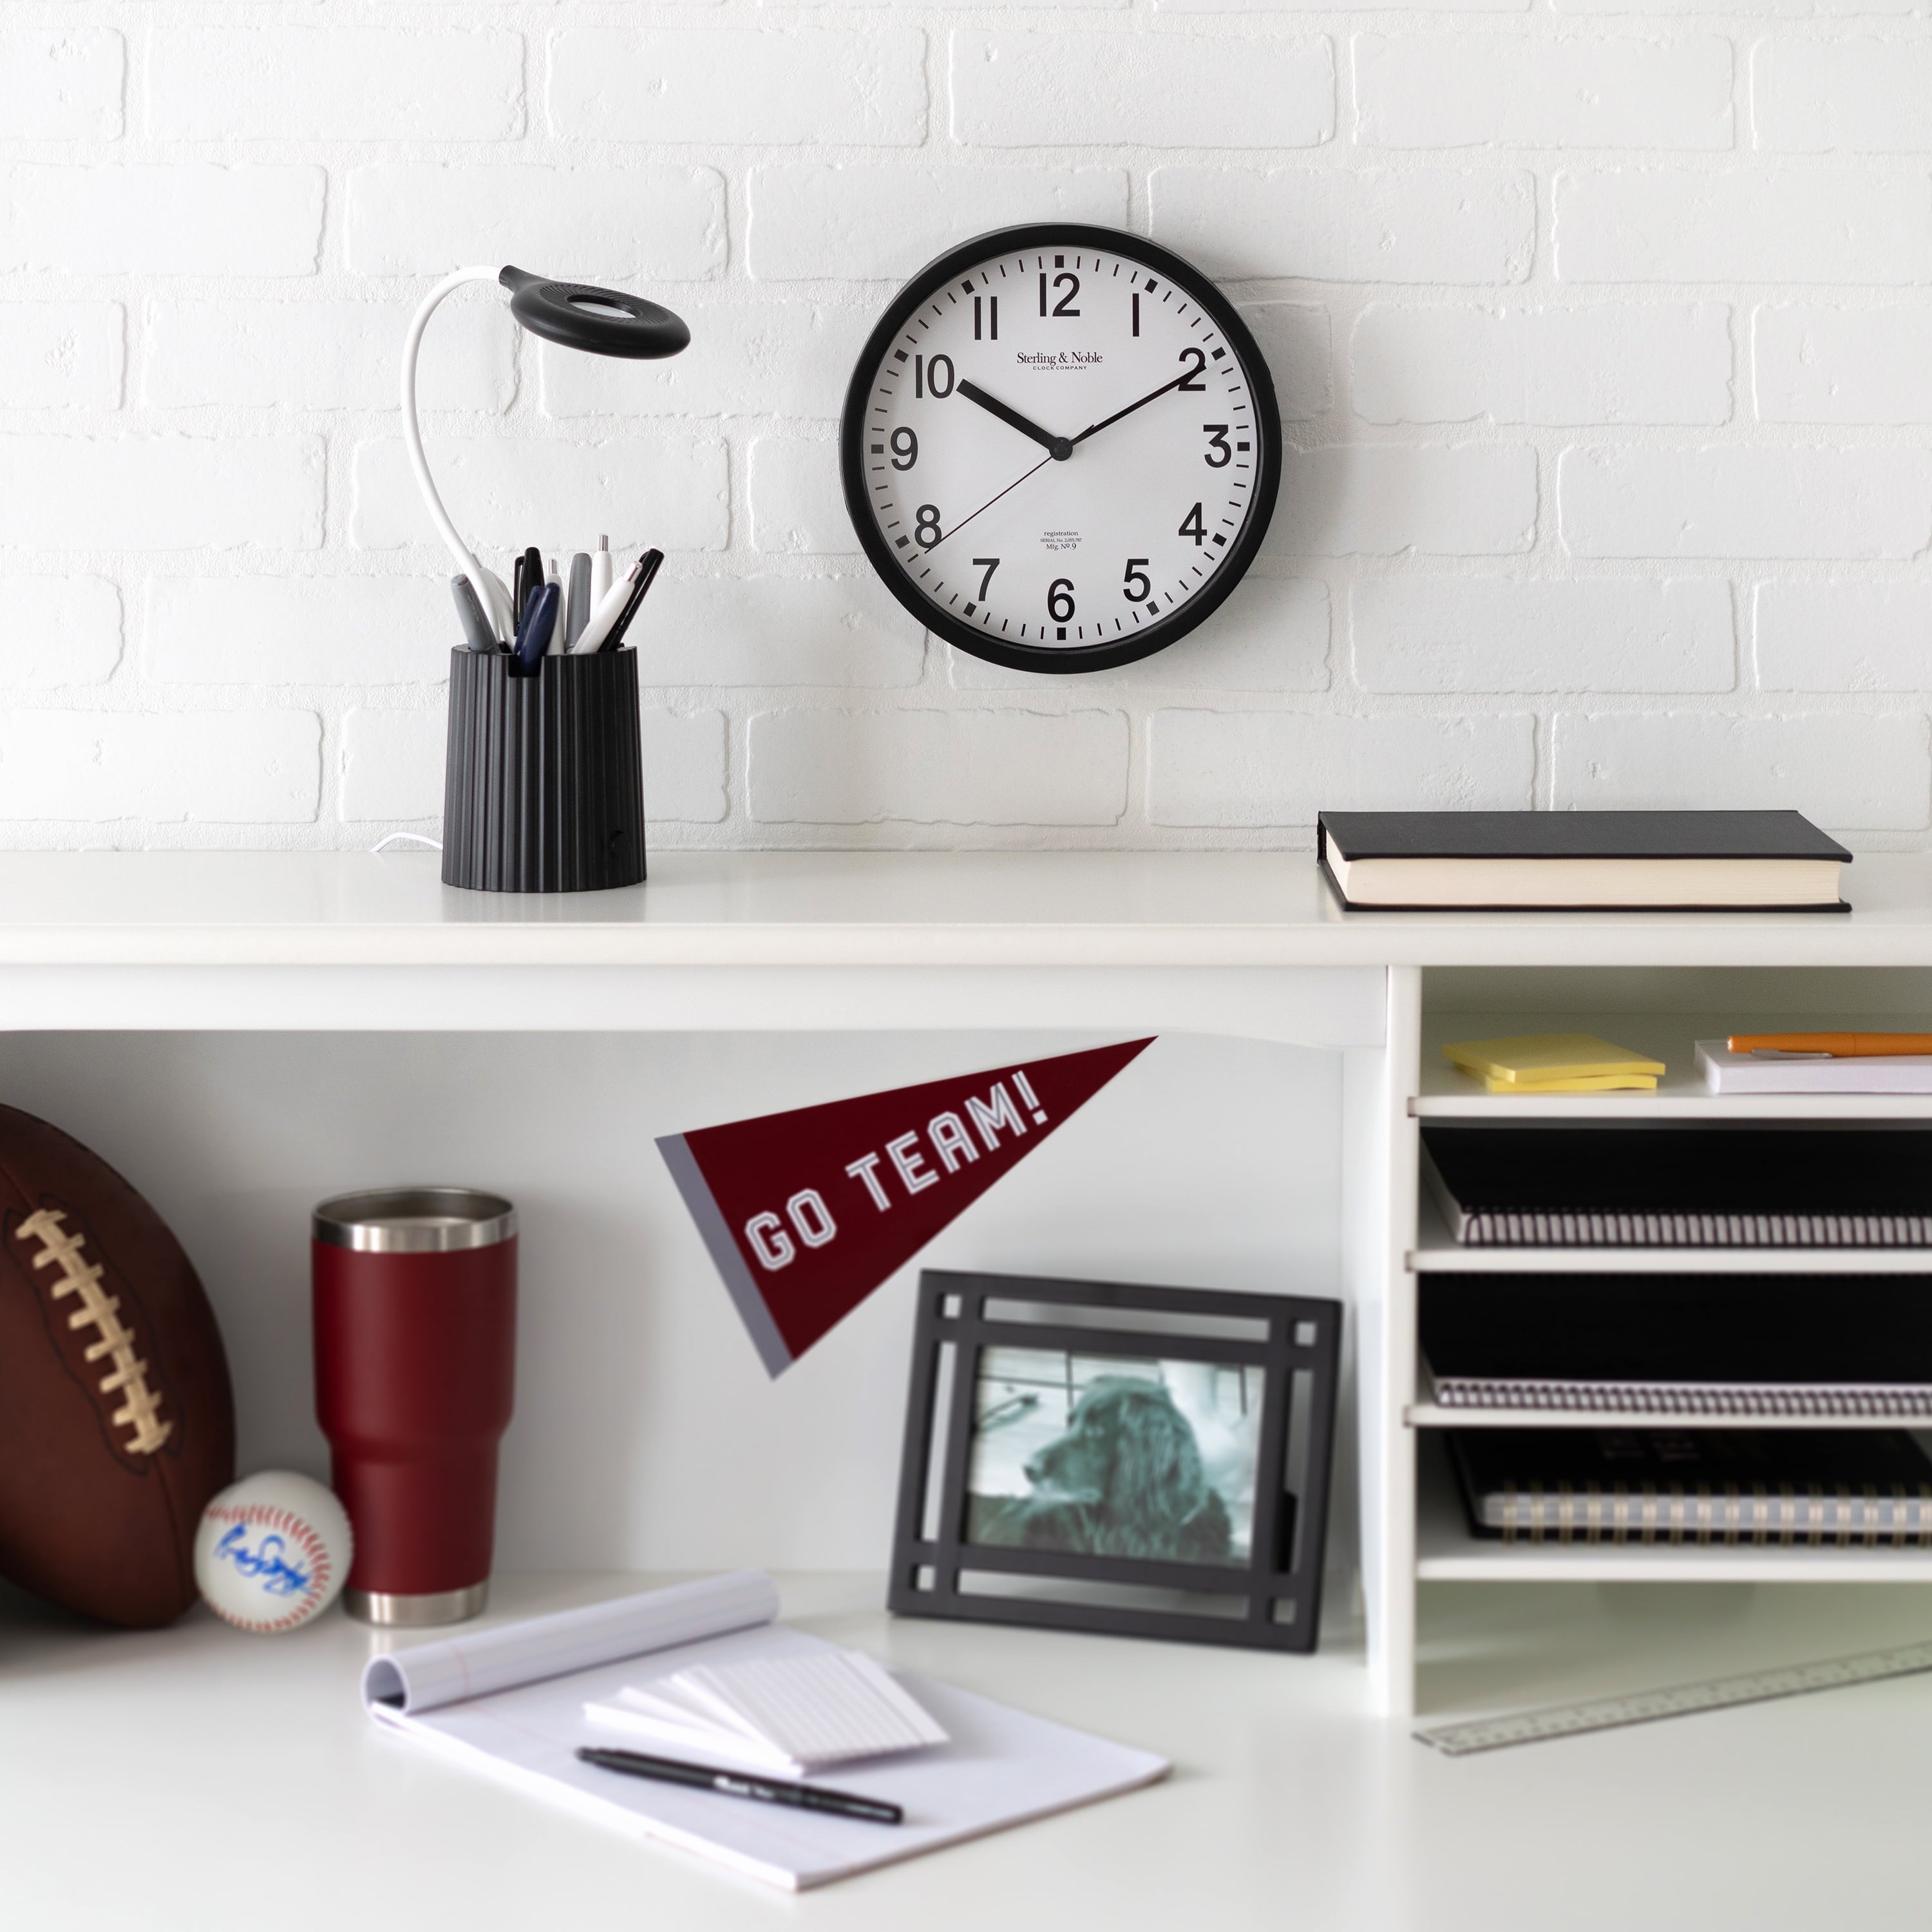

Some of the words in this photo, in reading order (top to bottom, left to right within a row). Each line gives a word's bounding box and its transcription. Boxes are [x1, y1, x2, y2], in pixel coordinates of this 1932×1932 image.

[1039, 272, 1081, 317] 12
[1132, 292, 1140, 337] 1
[974, 296, 998, 340] 11
[915, 354, 955, 399] 10
[1017, 352, 1056, 366] Sterling
[1058, 352, 1068, 363] &
[1071, 352, 1103, 363] Noble
[1178, 347, 1206, 392] 2
[890, 426, 918, 471] 9
[1204, 424, 1232, 468] 3
[914, 505, 942, 549] 8
[1178, 502, 1208, 546] 4
[1046, 543, 1059, 551] Mfg.
[972, 558, 1000, 601] 7
[1047, 578, 1075, 623] 6
[1122, 558, 1151, 603] 5
[744, 1188, 837, 1271] GO
[844, 1070, 1048, 1212] TEAM!
